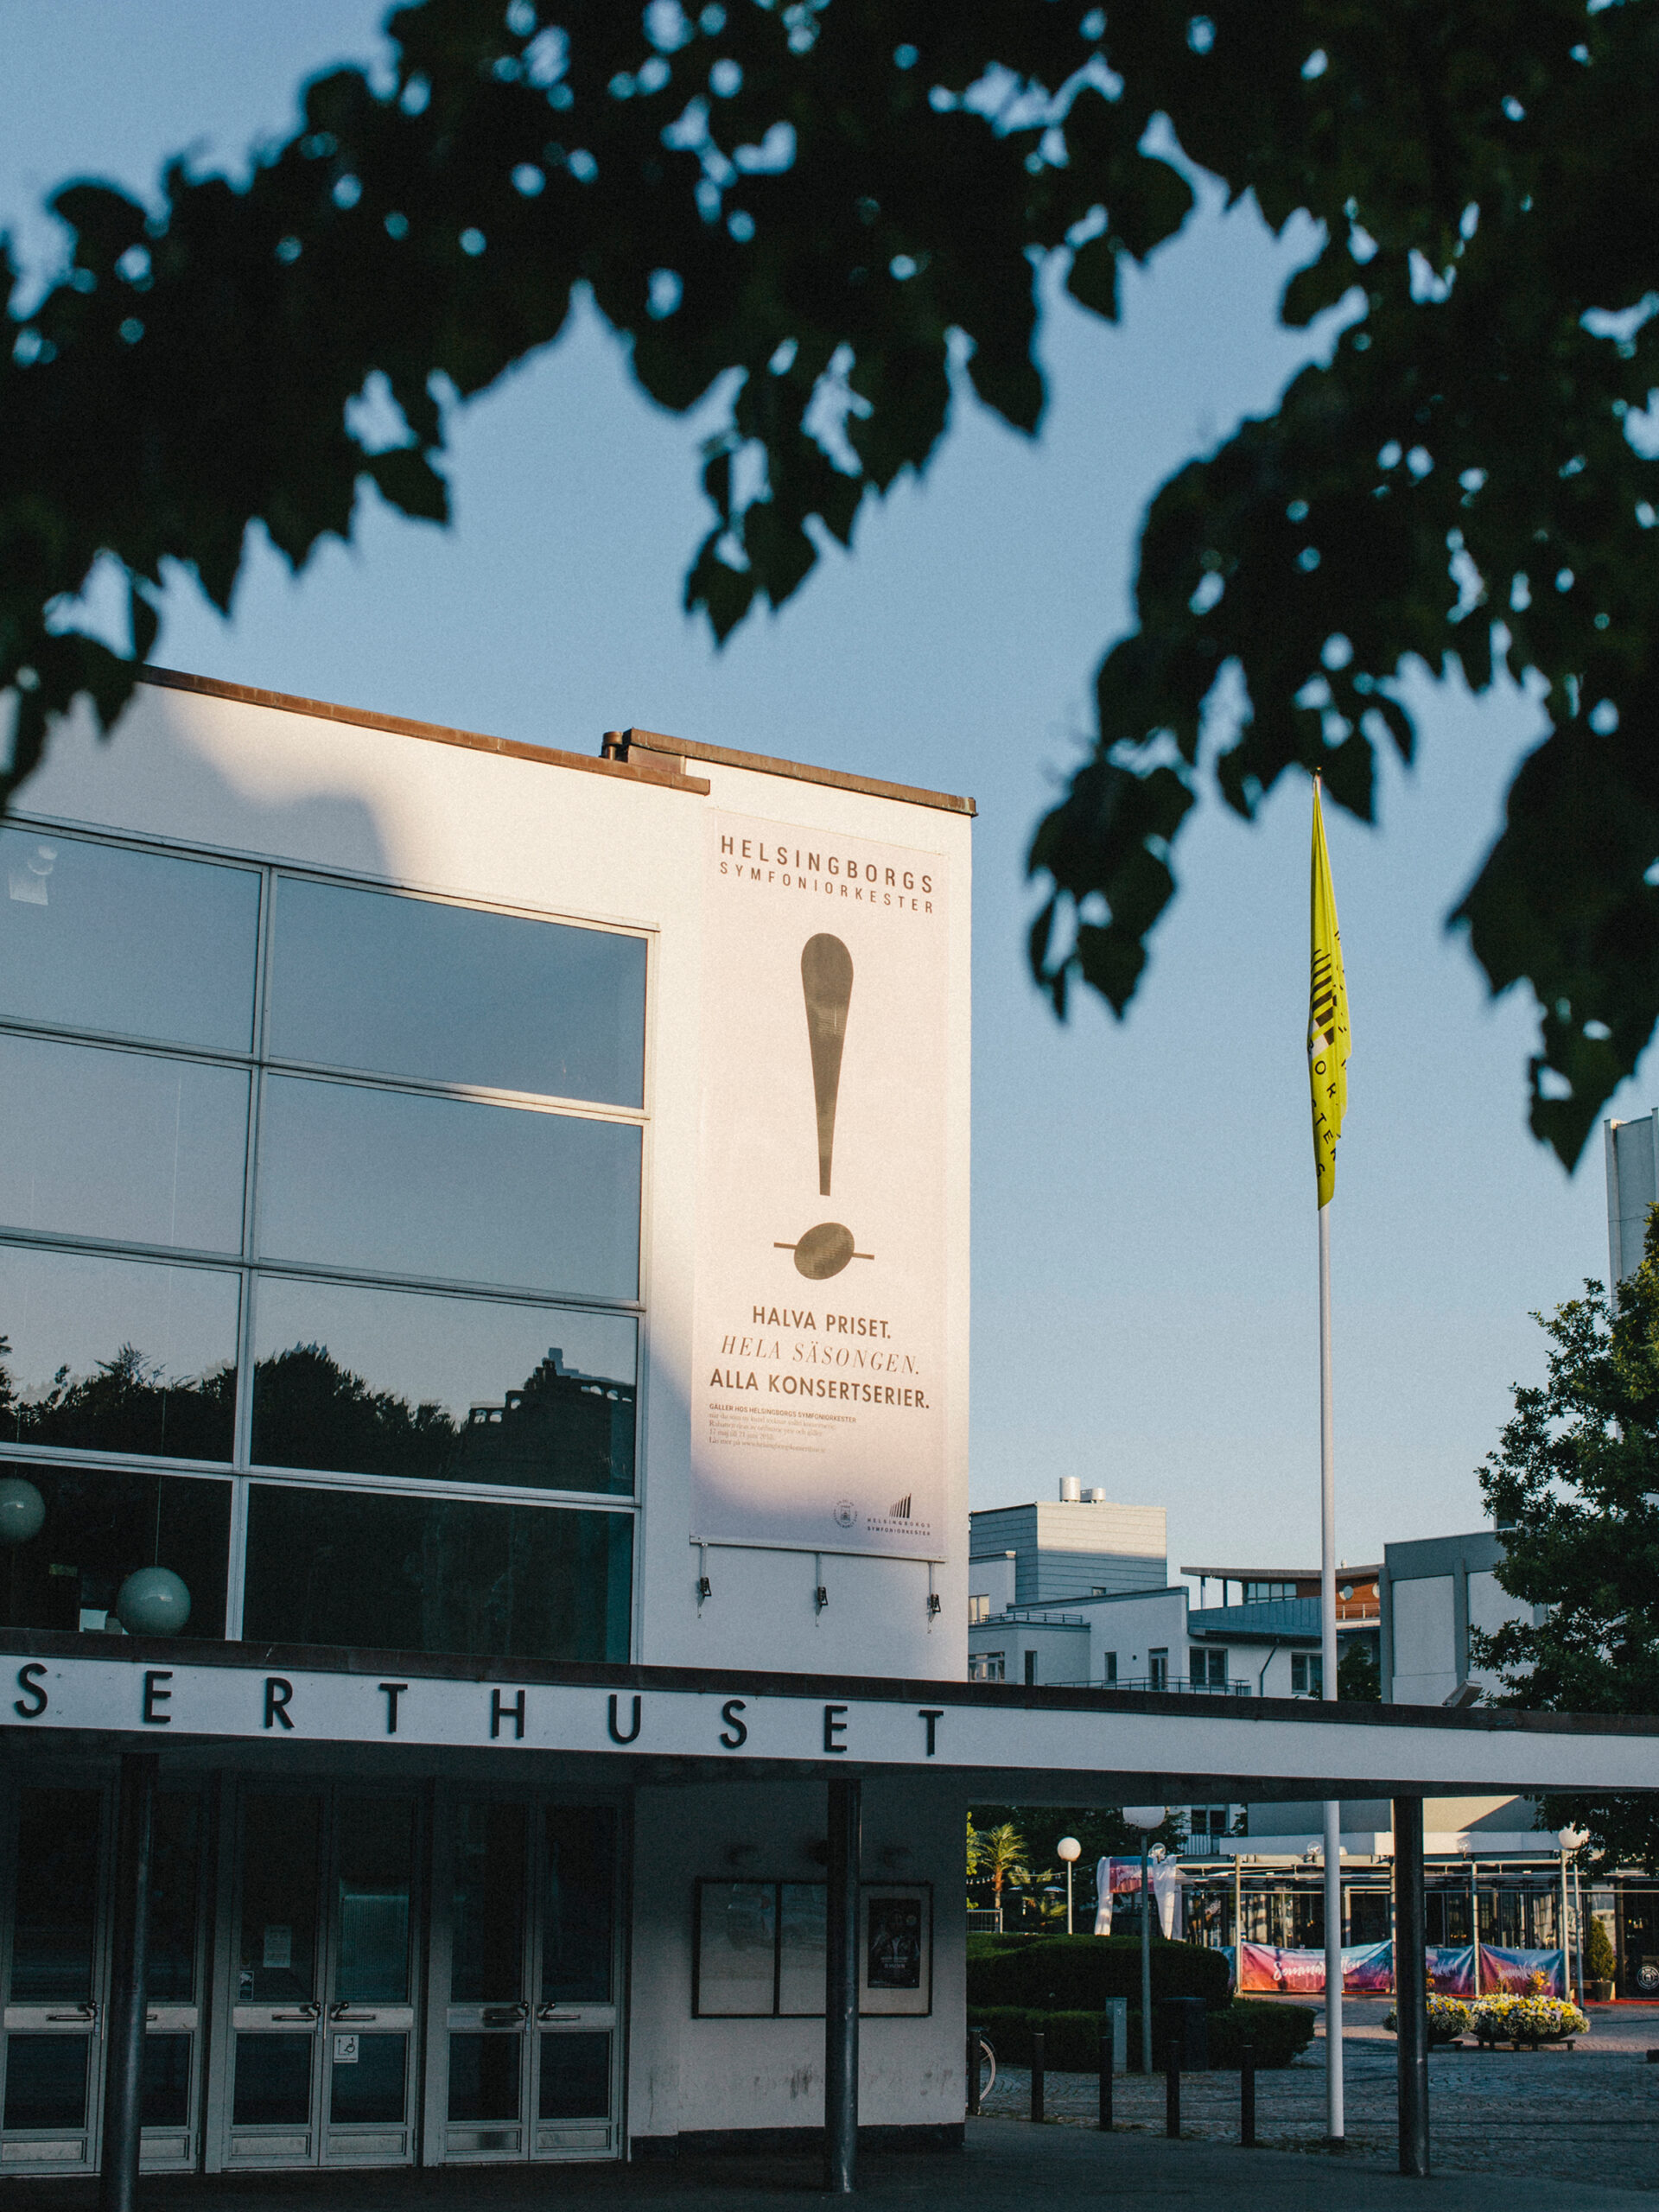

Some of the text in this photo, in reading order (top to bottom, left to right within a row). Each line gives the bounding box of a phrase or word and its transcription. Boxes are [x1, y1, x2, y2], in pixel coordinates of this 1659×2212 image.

[721, 835, 933, 893] HELSINGBORGS
[720, 861, 933, 913] SYMFONIORKESTER
[753, 1306, 891, 1339] HALVA PRISET.
[721, 1335, 919, 1375] HELA SÄSONGEN.
[709, 1369, 930, 1408] ALLA KONSERTSERIER.
[749, 1408, 797, 1418] HELSINGBORGS
[798, 1411, 857, 1423] SYMFONIORKESTER
[867, 1517, 931, 1528] HELSINGBORGS
